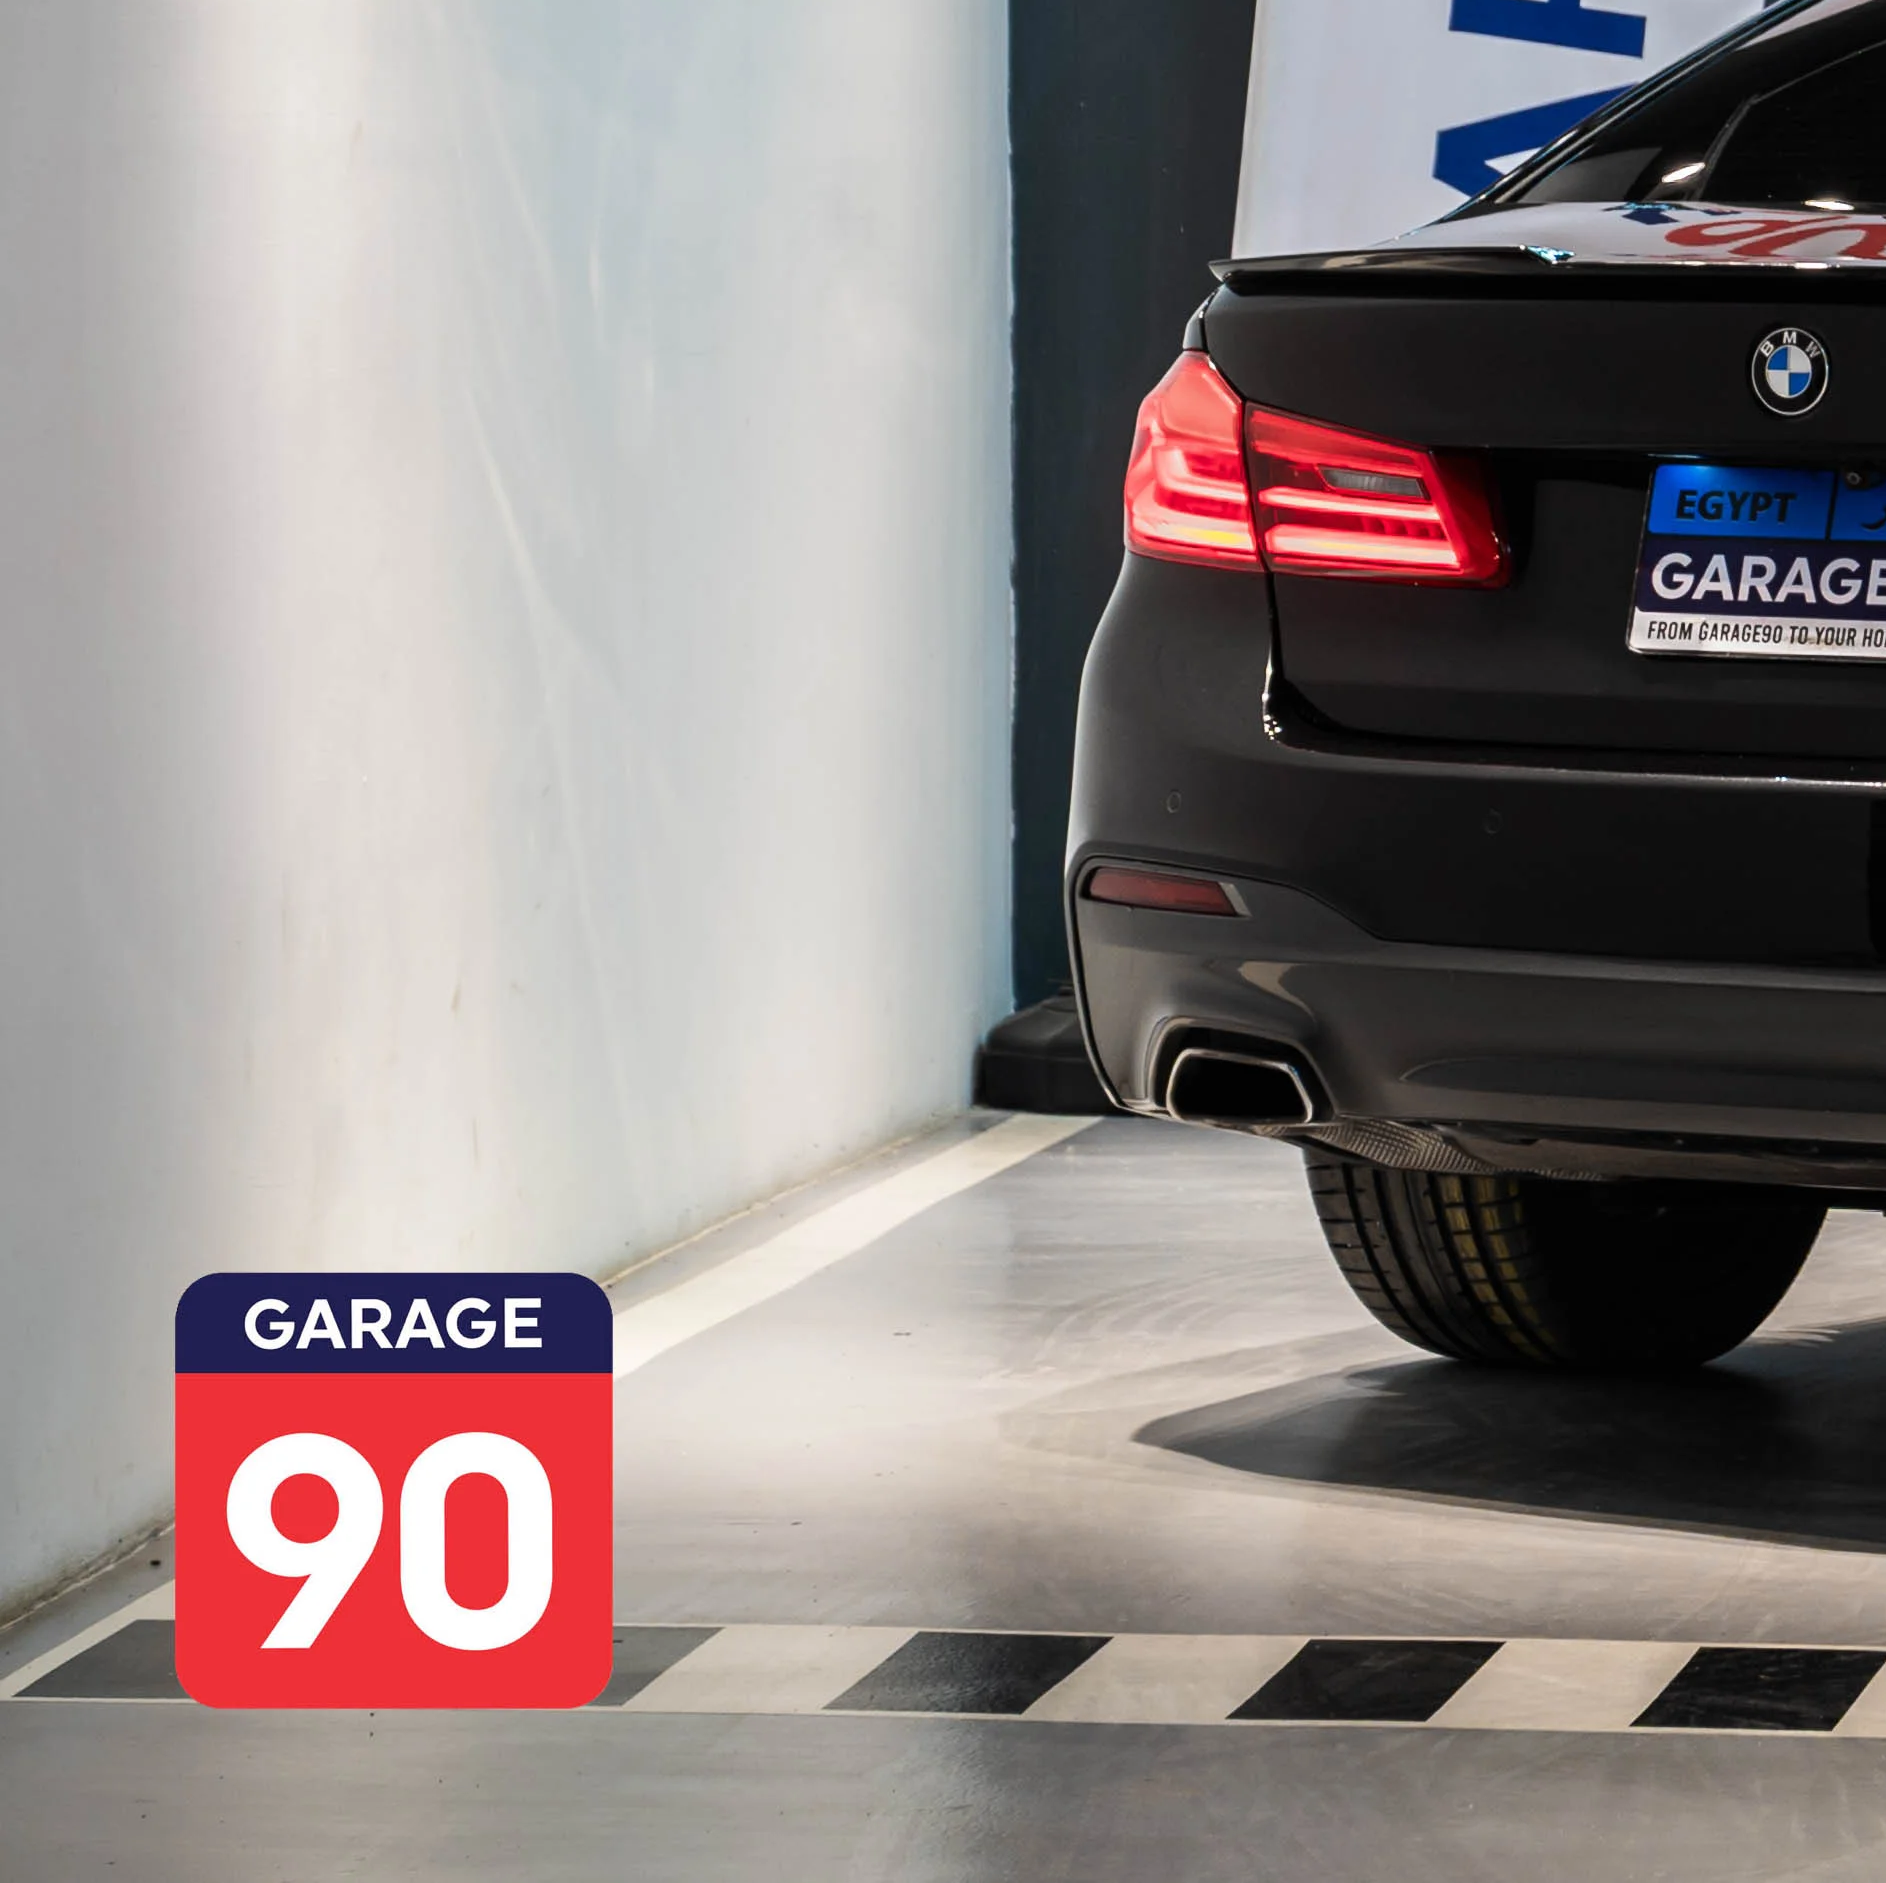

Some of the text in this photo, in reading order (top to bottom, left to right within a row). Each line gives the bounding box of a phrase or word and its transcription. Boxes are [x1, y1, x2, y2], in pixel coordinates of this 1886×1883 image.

[1759, 330, 1821, 359] BMW
[1675, 488, 1797, 523] EGYPT
[1647, 620, 1694, 641] FROM
[1698, 621, 1783, 645] GARAGE90
[1789, 625, 1809, 646] TO
[1814, 626, 1857, 648] YOUR
